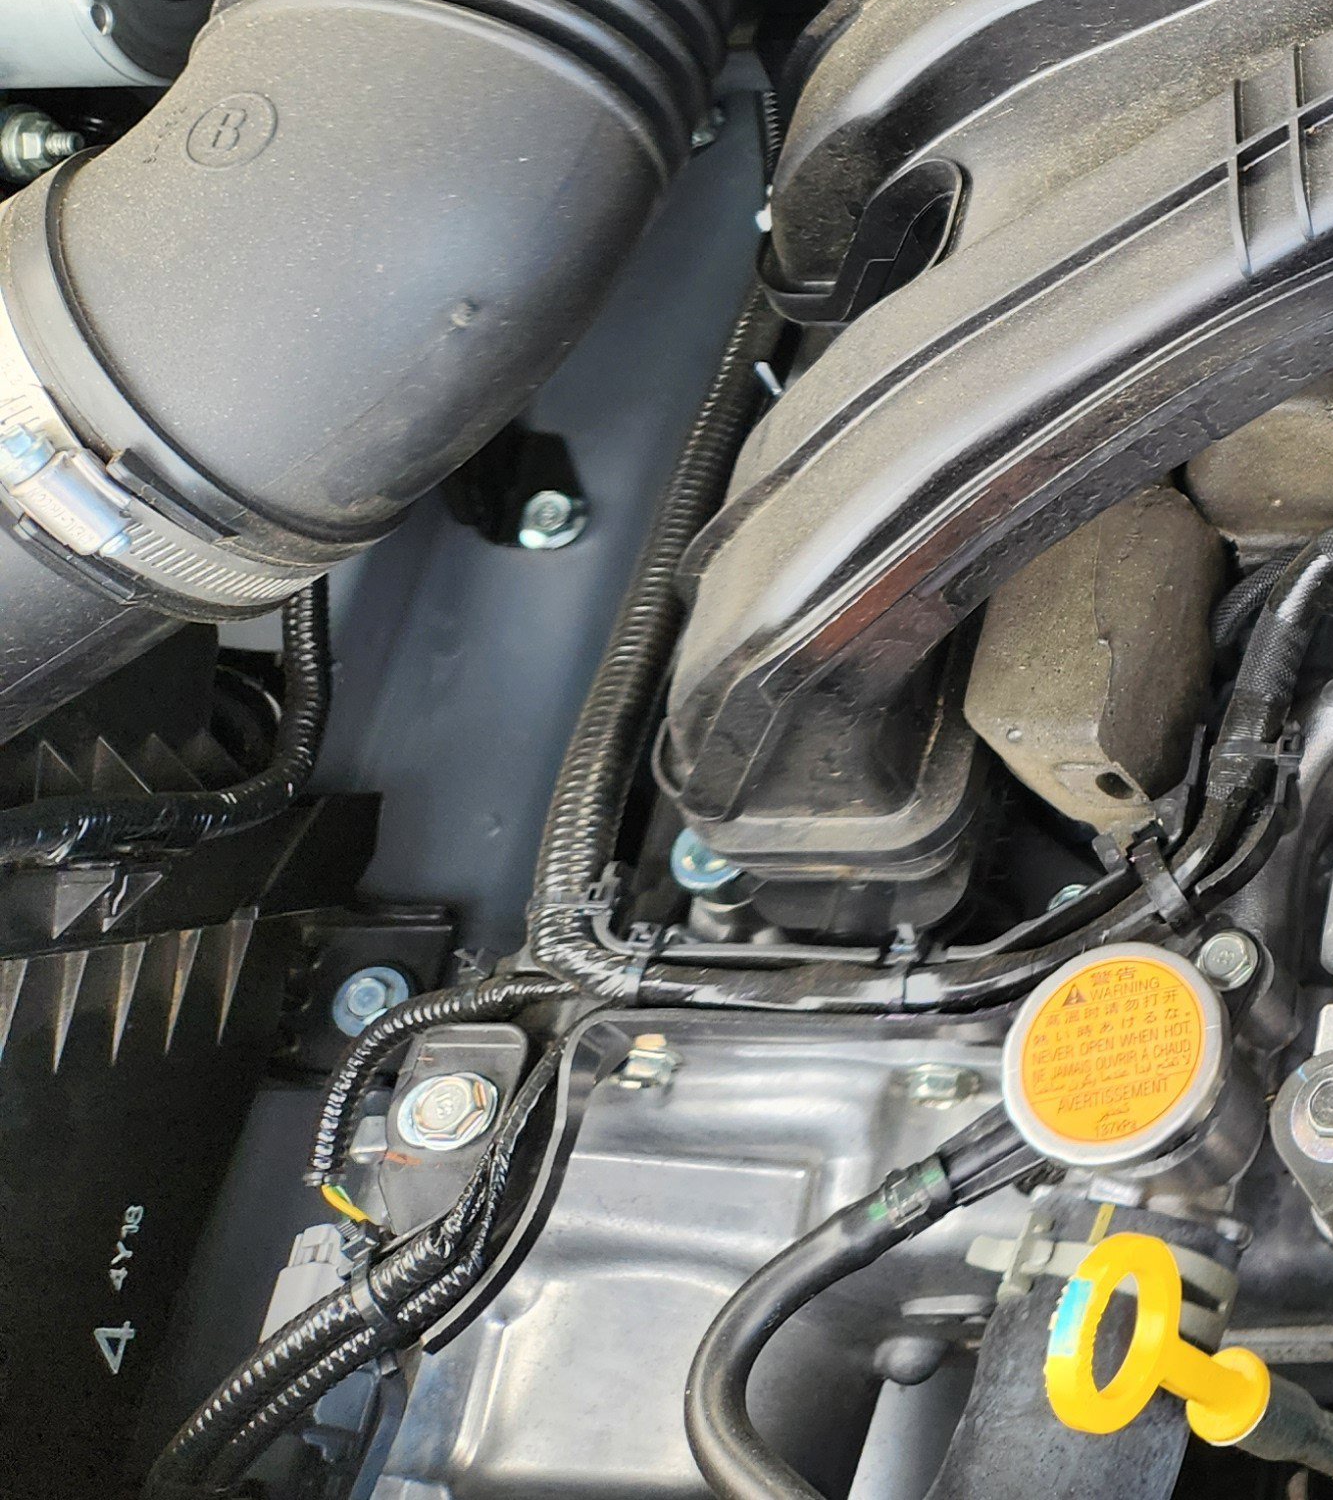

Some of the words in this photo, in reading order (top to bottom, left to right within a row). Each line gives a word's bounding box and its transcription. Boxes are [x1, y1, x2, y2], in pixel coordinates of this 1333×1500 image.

[212, 108, 247, 151] B
[1089, 976, 1161, 1002] WARNING
[1090, 967, 1137, 987] 警告
[1032, 1044, 1074, 1066] NEVER
[1080, 1036, 1115, 1059] OPEN
[1120, 1028, 1159, 1049] WHEN
[1051, 1059, 1092, 1081] JAMAIS
[1096, 1051, 1137, 1071] OUVRIR
[1153, 1038, 1192, 1058] CHAUD
[1057, 1077, 1169, 1117] AVERTISSEMENT
